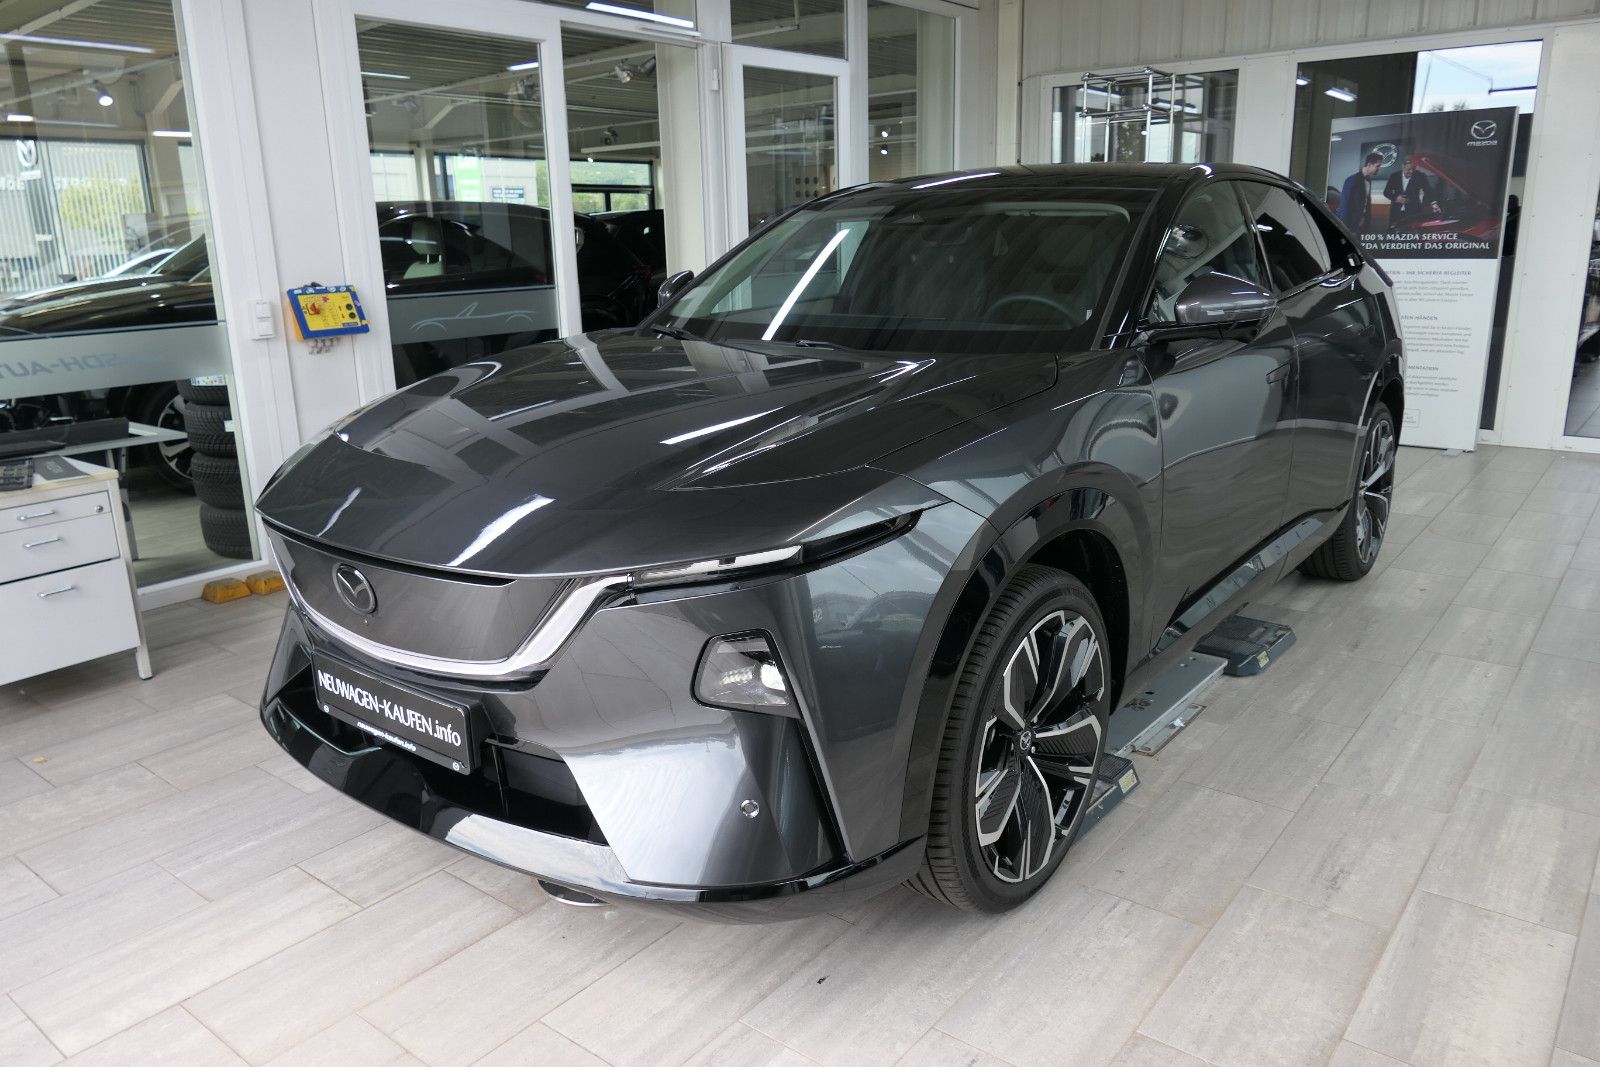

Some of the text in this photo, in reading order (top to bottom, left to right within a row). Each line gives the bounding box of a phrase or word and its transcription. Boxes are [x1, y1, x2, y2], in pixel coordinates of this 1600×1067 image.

[1360, 233, 1376, 241] 100
[1386, 233, 1420, 241] MAZDA
[1380, 242, 1422, 250] VERDIENT
[1424, 242, 1443, 250] DAS
[318, 670, 461, 747] NEUWAGEN-KAUFEN.info
